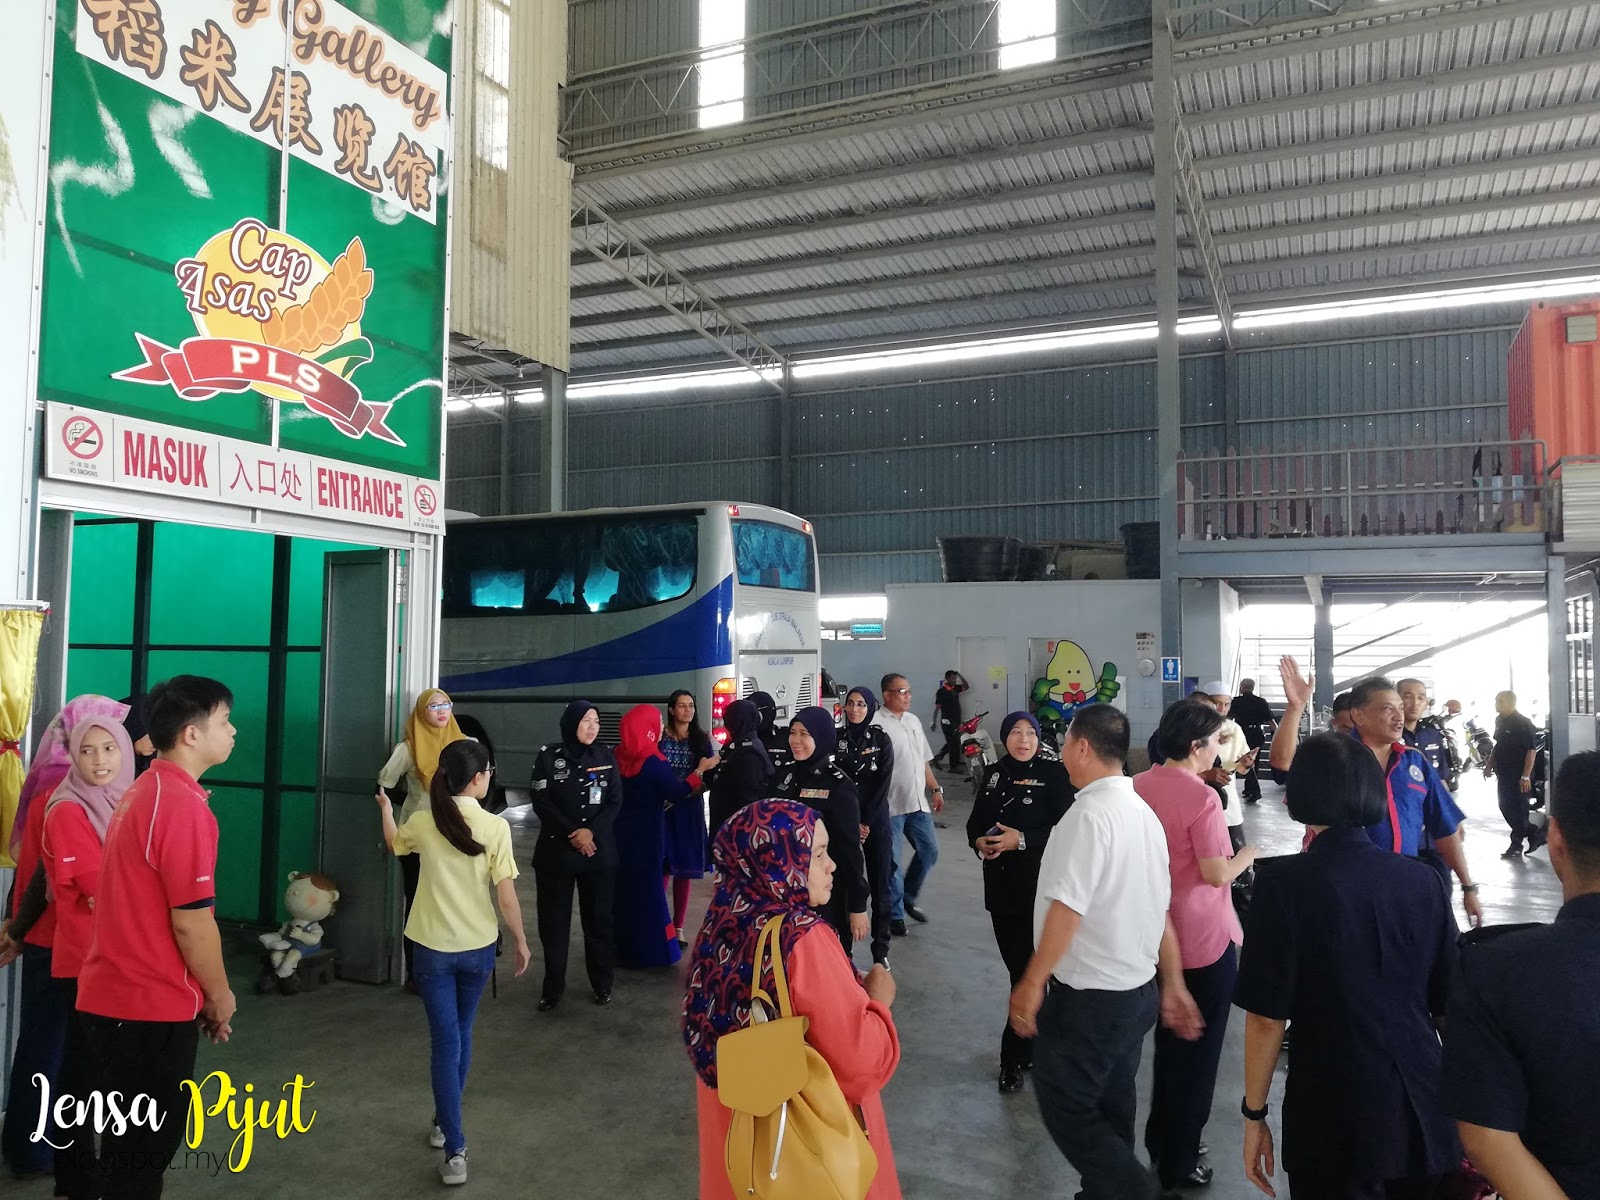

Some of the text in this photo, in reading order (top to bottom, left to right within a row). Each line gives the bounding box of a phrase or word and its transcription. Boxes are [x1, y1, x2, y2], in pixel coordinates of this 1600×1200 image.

[280, 0, 440, 131] Gallery
[80, 0, 437, 212] 稻米展览馆
[229, 218, 312, 301] Cap
[176, 259, 277, 323] Asas
[230, 344, 322, 393] PLS
[77, 468, 98, 477] SMOKING
[123, 430, 209, 489] MASUK
[229, 452, 302, 502] 入口处
[317, 466, 404, 519] ENTRANCE
